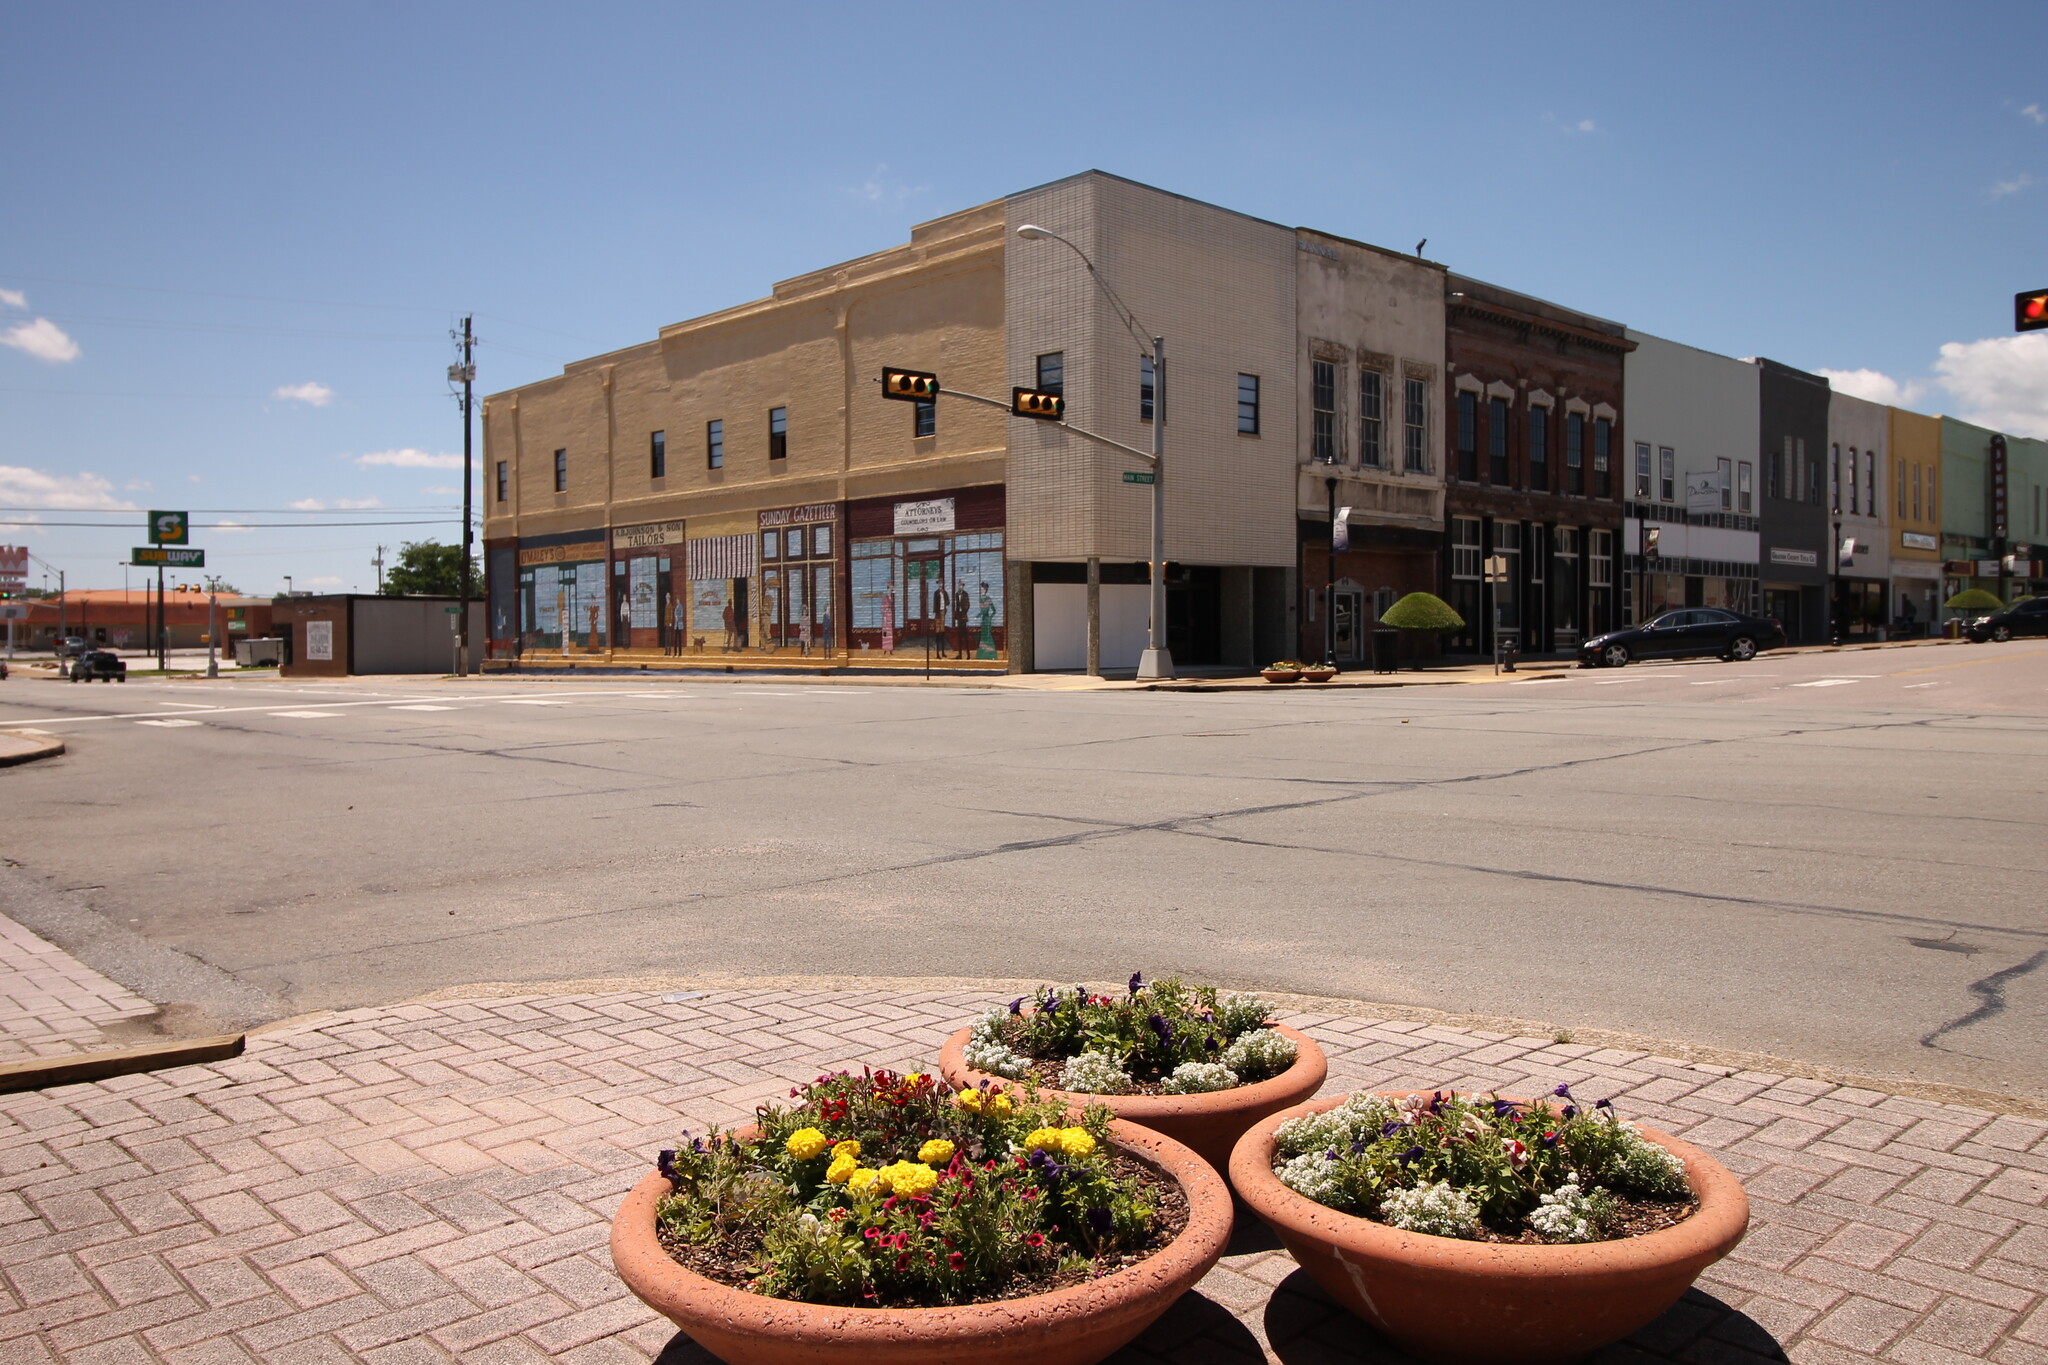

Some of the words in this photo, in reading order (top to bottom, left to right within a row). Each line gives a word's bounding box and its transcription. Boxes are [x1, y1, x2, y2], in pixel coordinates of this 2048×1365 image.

[1136, 474, 1153, 483] STREET
[760, 510, 791, 526] SUNDAY
[793, 504, 836, 522] GAZETTEER
[905, 506, 942, 517] ATTORNEYS
[658, 524, 663, 532] &
[666, 522, 681, 532] SON
[628, 533, 665, 547] TAILORS
[139, 550, 202, 562] SUBWAY
